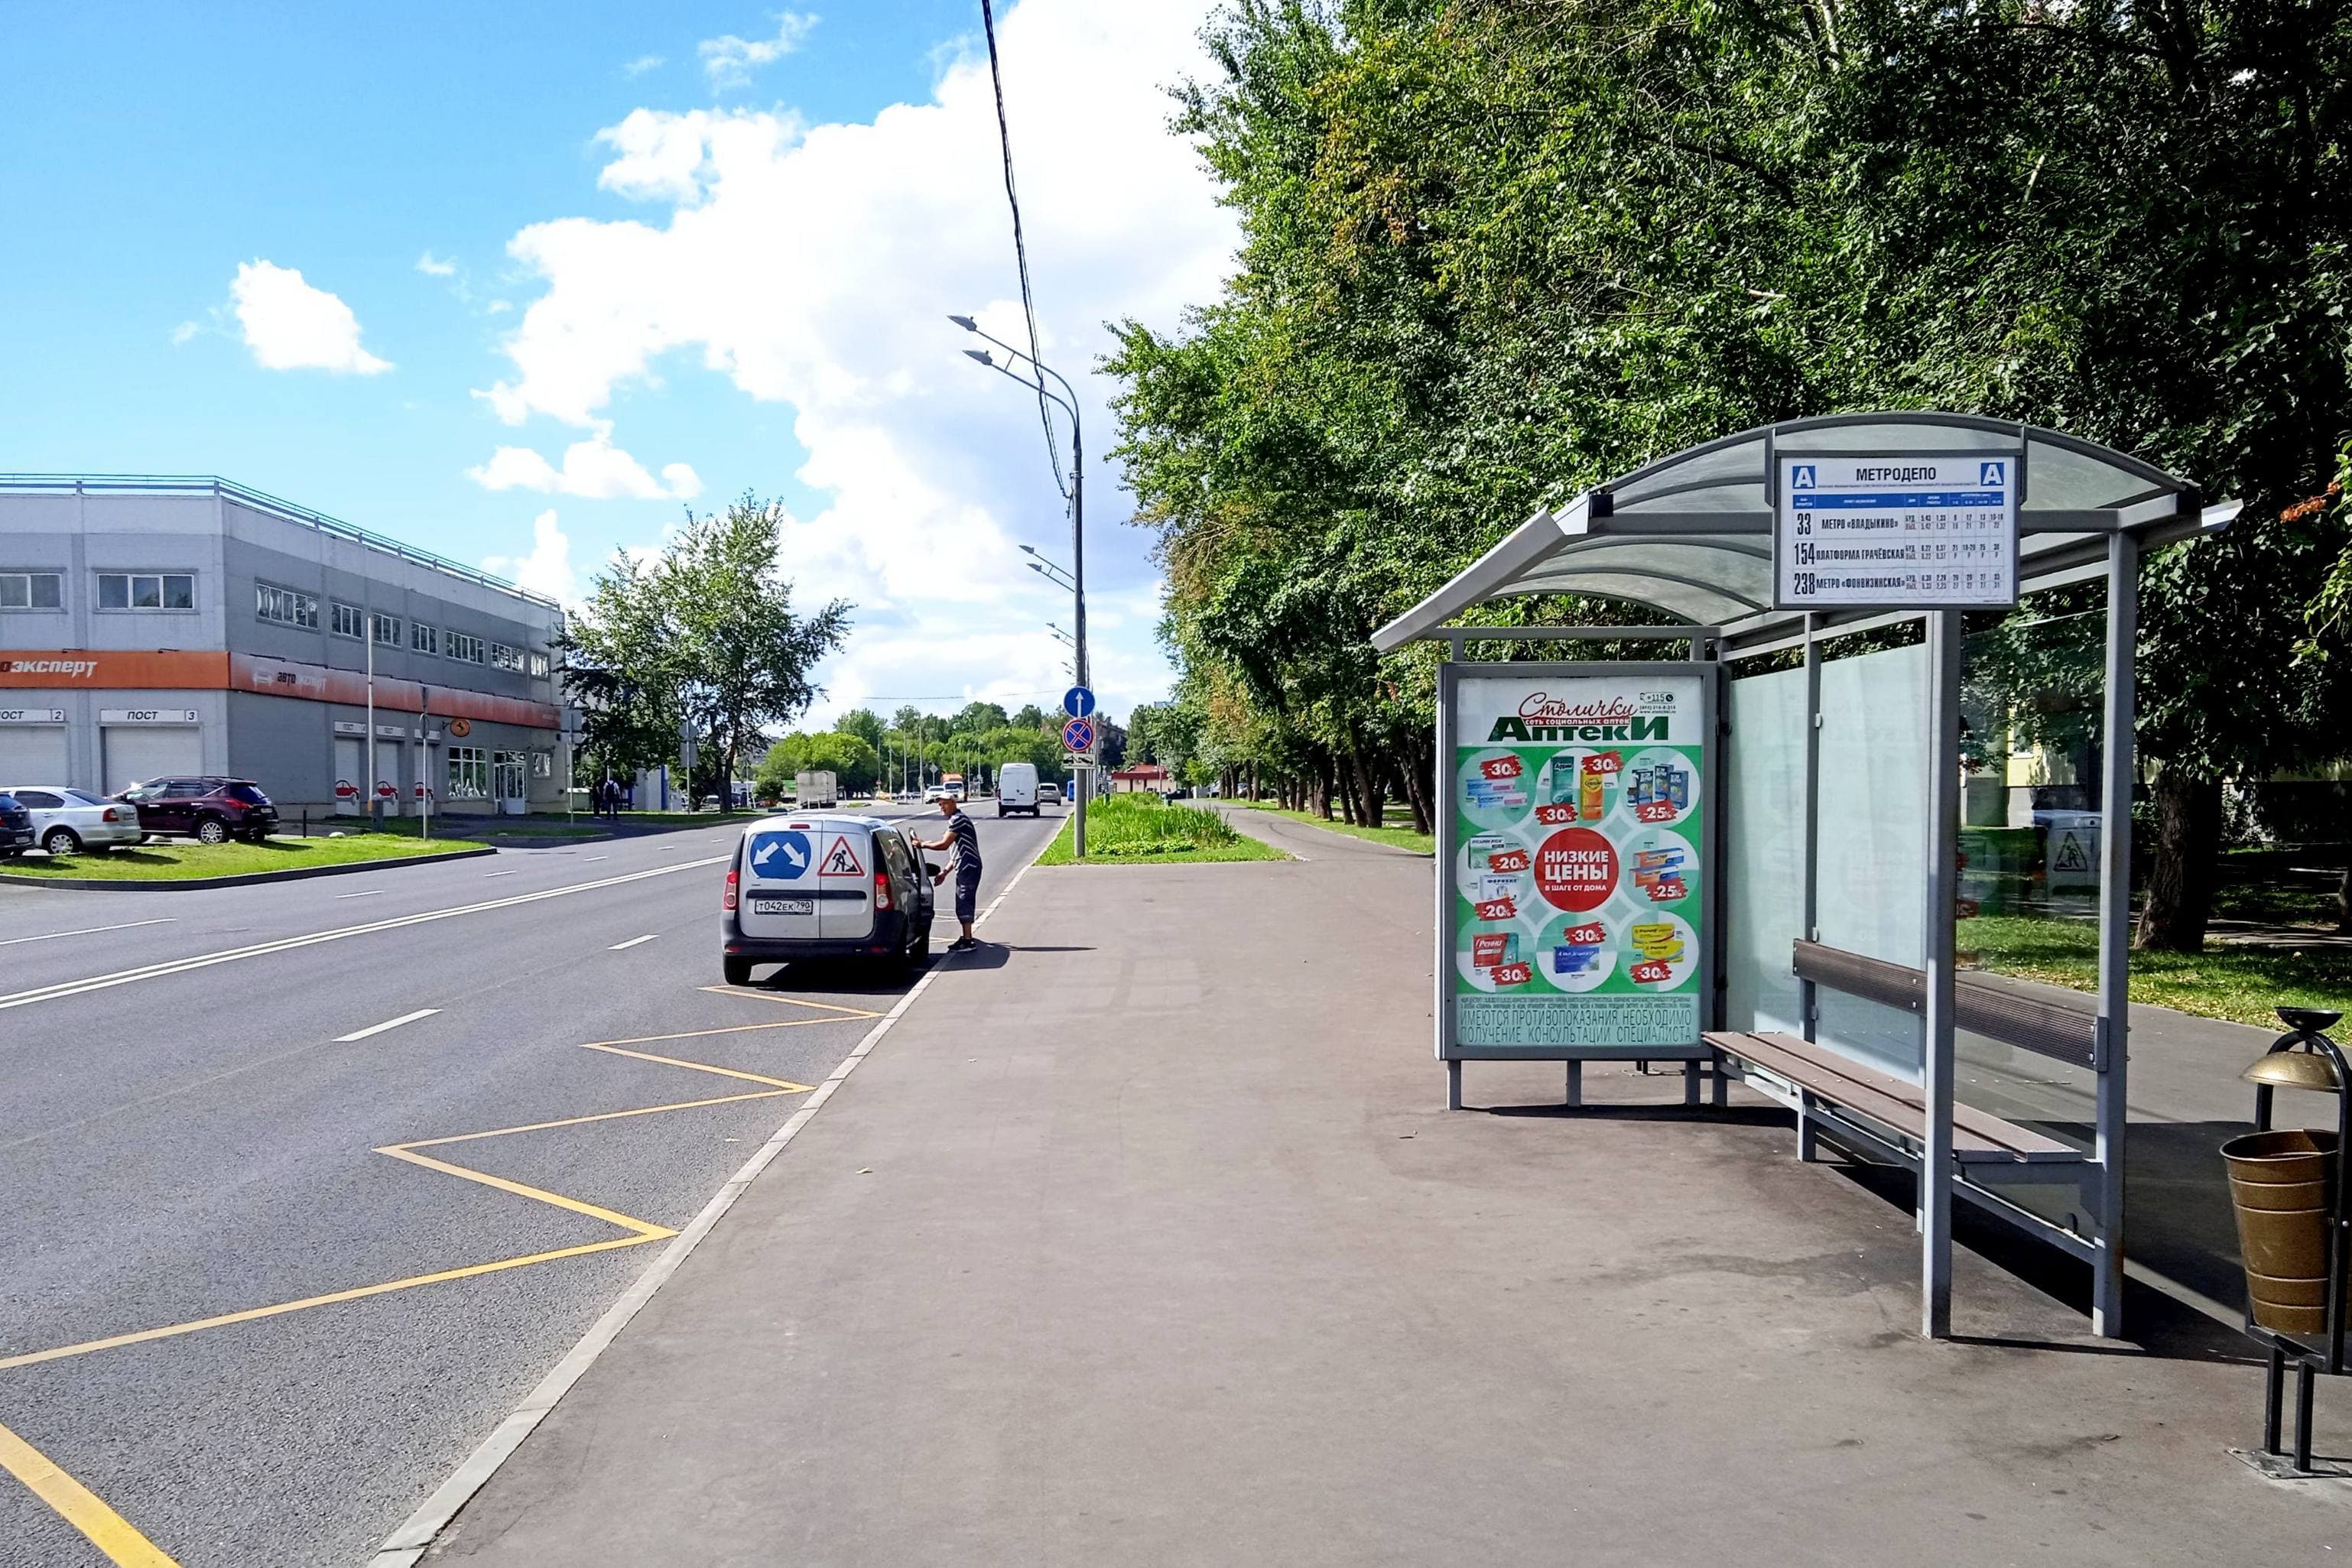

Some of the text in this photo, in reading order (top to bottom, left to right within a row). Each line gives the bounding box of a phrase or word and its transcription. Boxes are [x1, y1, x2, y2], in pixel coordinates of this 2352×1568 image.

[1856, 467, 1937, 482] МЕТРОДЕПО
[1797, 513, 1899, 535] 33 МЕТРО «ВЛАДЫКИНО»
[1794, 543, 1905, 564] 154 ПЛАТФОРМА ГРАЧЁВСКАЯ
[1794, 573, 1905, 594] 238 МЕТРО «ФОНВИЗИНСКАЯ»
[1519, 692, 1638, 716] Столички
[0, 711, 62, 719] ОСТ 2
[127, 711, 159, 719] ПОСТ
[1487, 763, 1517, 776] -30%
[1590, 758, 1619, 771] -30%
[1542, 809, 1572, 821] -30%
[1643, 807, 1672, 820] -25%
[1496, 857, 1525, 869] -20%
[1545, 851, 1609, 863] НИЗКИЕ
[1545, 865, 1608, 883] ЦЕНЫ
[1584, 885, 1607, 893] ДОМА
[1653, 885, 1682, 898] -25%
[1482, 904, 1512, 917] -20%
[1571, 929, 1600, 942] -30%
[1498, 969, 1527, 982] -30%
[1637, 967, 1667, 979] -30%
[1460, 1008, 1691, 1026] ИМЕЮТСЯ ПРОТИВОПОКАЗАНИЯ НЕОБХОДИМО
[1460, 1026, 1692, 1044] ПОЛУЧЕНИЕ КОНСУЛЬТАЦИИ СПЕЦИАЛИСТА
